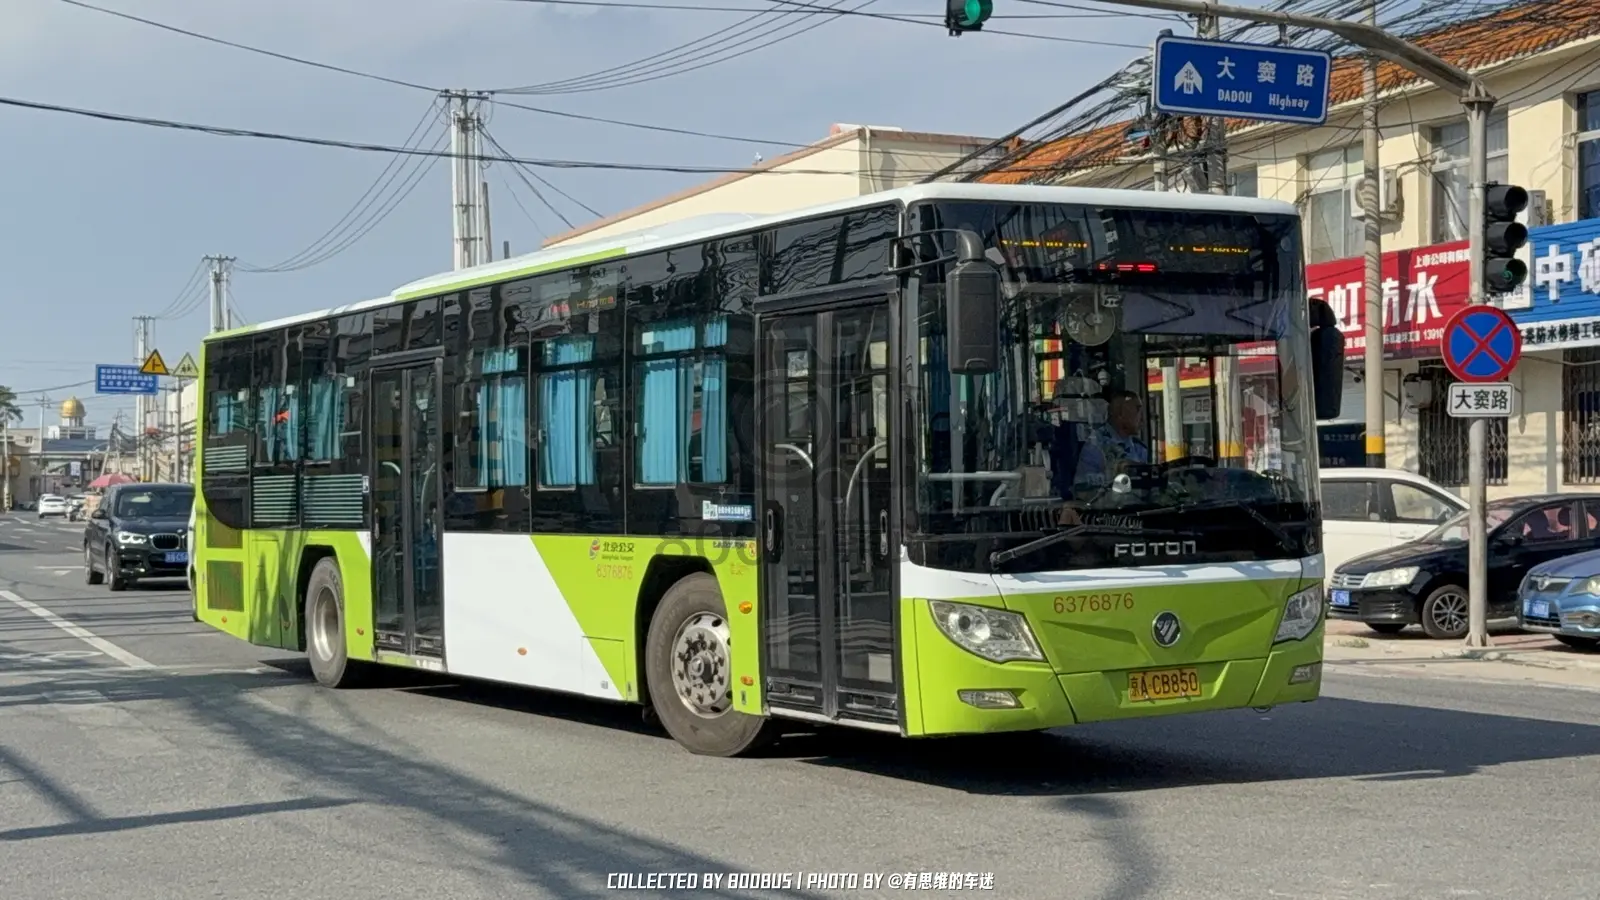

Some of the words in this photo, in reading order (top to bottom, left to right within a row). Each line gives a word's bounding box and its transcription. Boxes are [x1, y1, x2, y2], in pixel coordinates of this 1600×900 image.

[1216, 56, 1315, 87] 大窦路
[1217, 89, 1252, 104] DADOU
[1268, 93, 1310, 112] Highway
[1454, 389, 1508, 410] 大窦路
[602, 541, 635, 553] 北京公交
[1114, 541, 1196, 557] FOTON
[1053, 592, 1135, 614] 6376876
